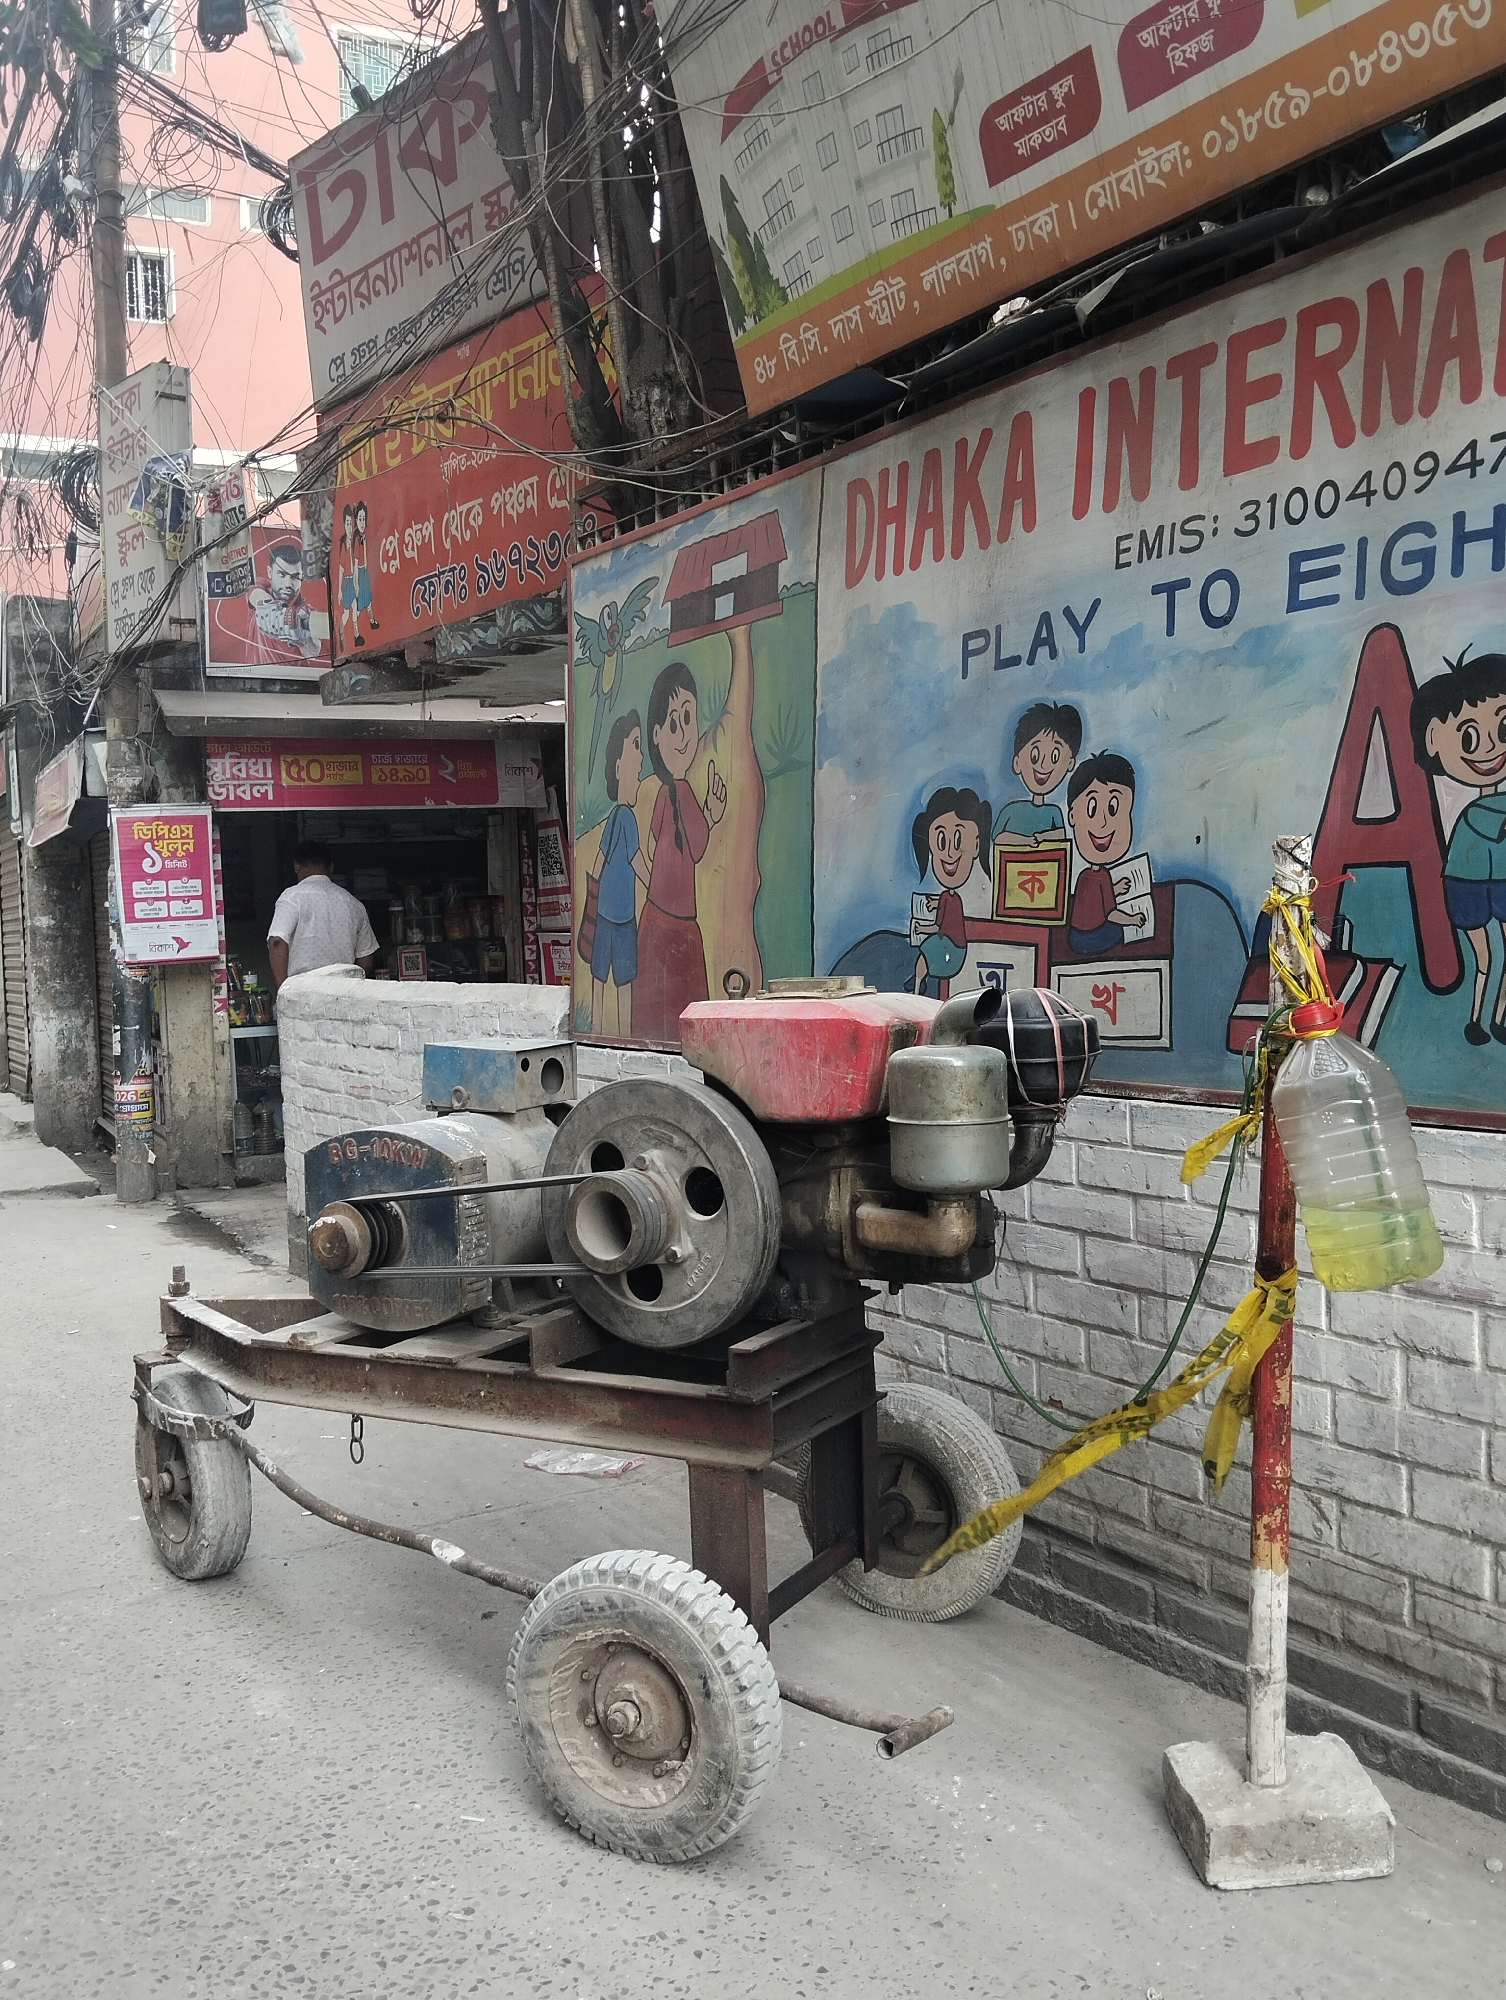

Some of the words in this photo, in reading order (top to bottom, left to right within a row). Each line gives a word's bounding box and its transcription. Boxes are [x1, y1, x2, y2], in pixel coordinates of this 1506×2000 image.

[769, 10, 836, 77] SCHOOL
[1166, 28, 1215, 74] হিফজ
[994, 92, 1047, 133] আফটার
[1048, 73, 1076, 110] স্কুল
[1014, 114, 1069, 158] মাকতাব
[753, 354, 777, 384] ৪৮
[828, 303, 864, 346] দাস
[1007, 202, 1061, 253] ঢাকা
[843, 410, 1037, 591] DHAKA
[379, 534, 401, 575] প্লে
[442, 499, 484, 547] থেকে
[1114, 513, 1220, 571] EMIS:
[960, 598, 1101, 680] PLAY
[1151, 568, 1240, 637] TO
[1285, 502, 1506, 615] EIGH
[206, 751, 273, 782] সুবিধা
[132, 821, 194, 840] ডিপিএস
[154, 838, 195, 858] খুলুন
[141, 841, 163, 874] ১
[1016, 870, 1049, 903] ক
[1091, 981, 1127, 1026] খ
[114, 1090, 137, 1102] 026
[328, 1136, 429, 1169] BG-10KW
